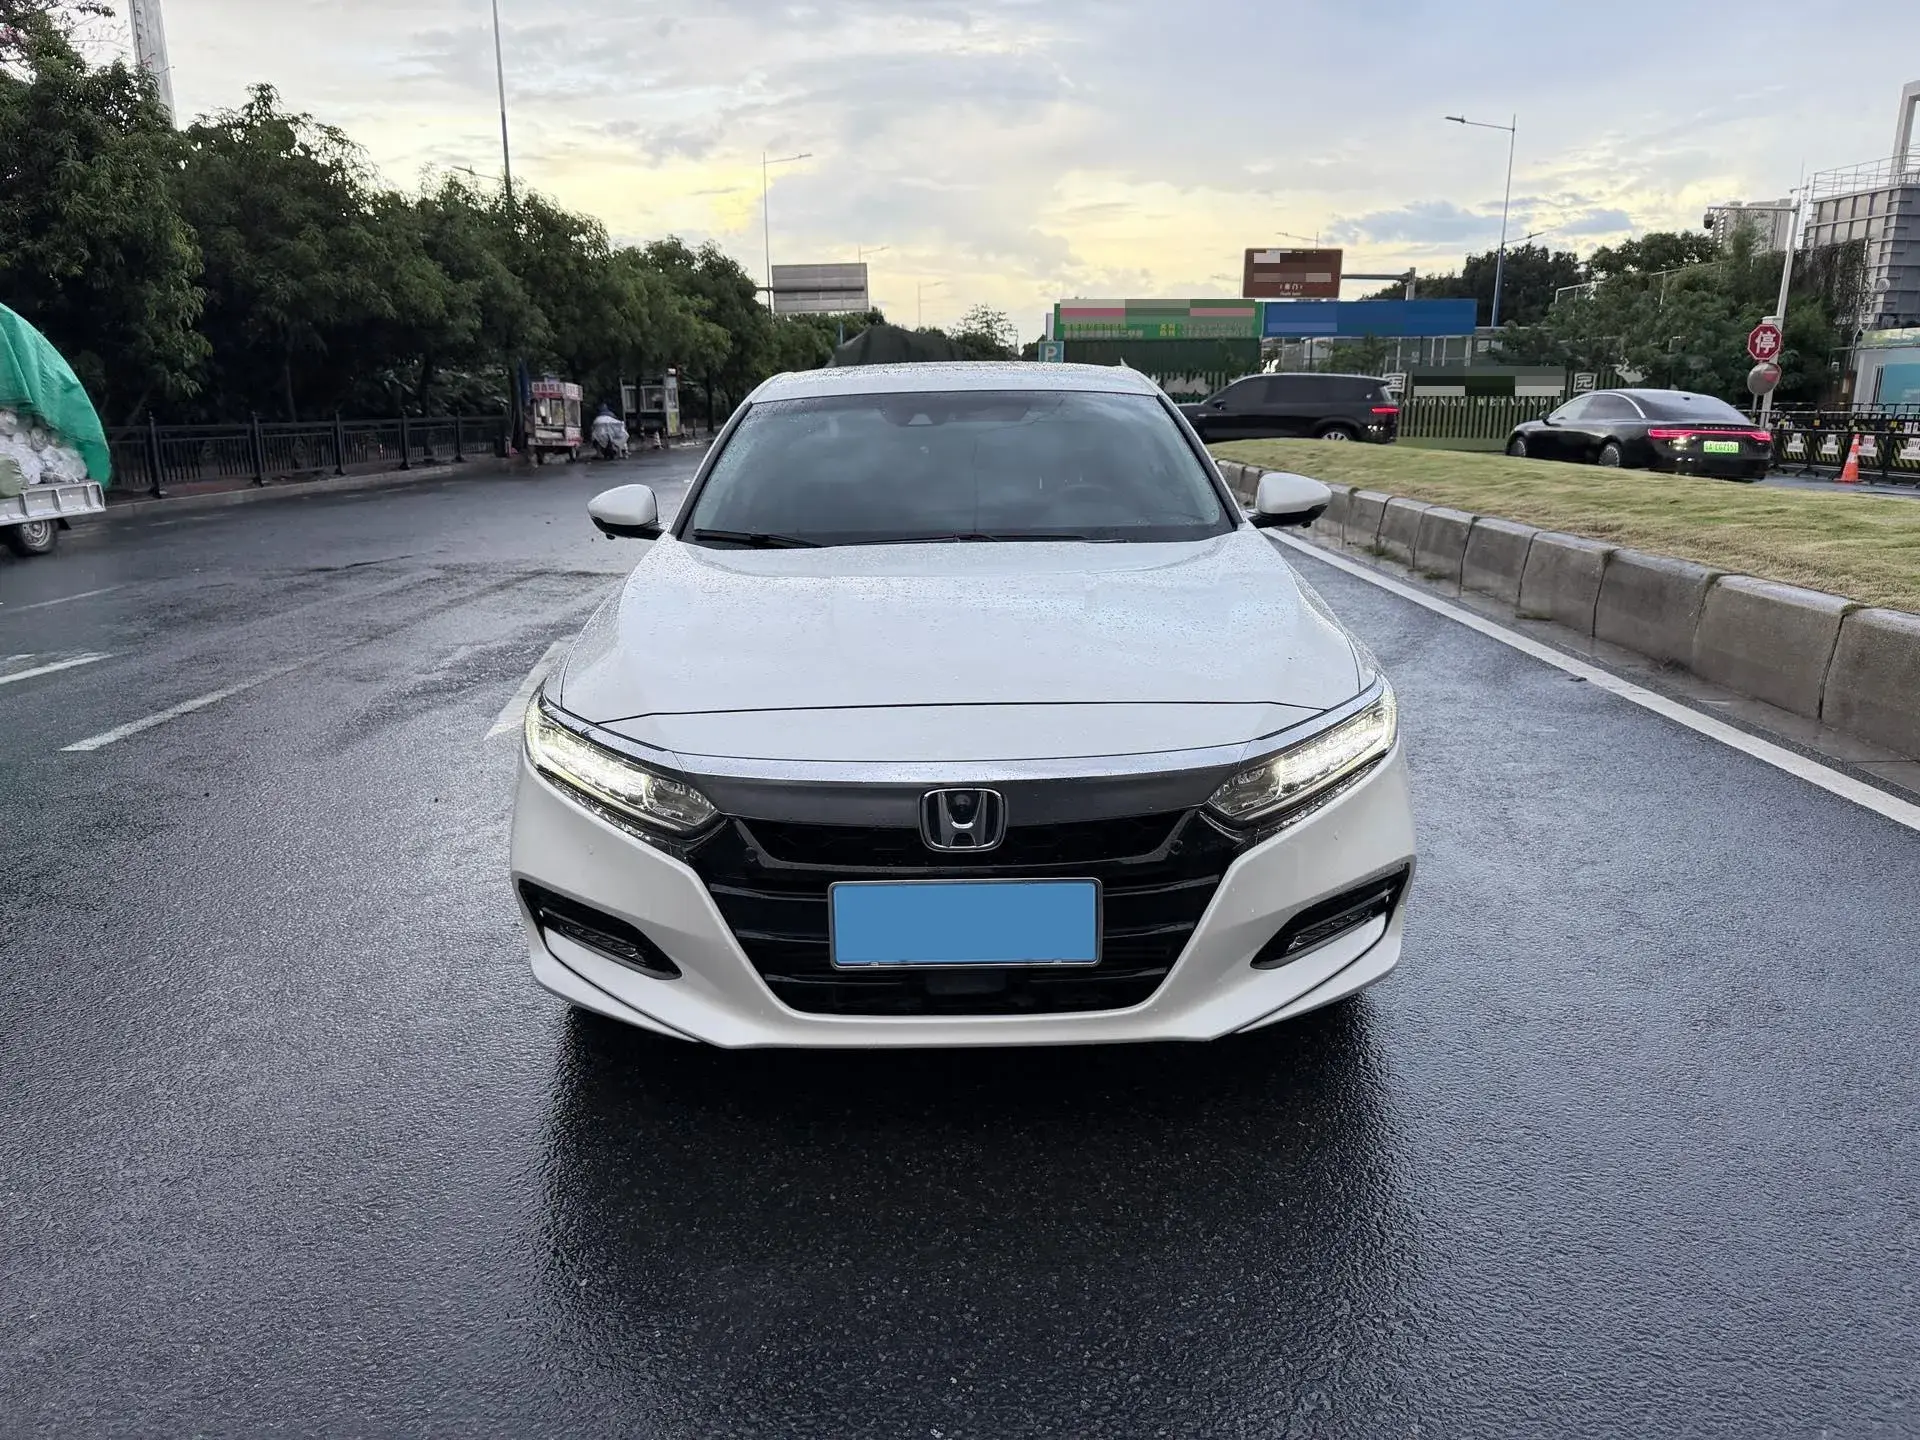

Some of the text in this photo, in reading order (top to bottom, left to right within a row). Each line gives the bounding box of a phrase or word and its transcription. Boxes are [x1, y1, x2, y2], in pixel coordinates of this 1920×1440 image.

[1755, 331, 1776, 354] 停
[1045, 345, 1057, 361] P
[1403, 398, 1467, 407] ATIONAL
